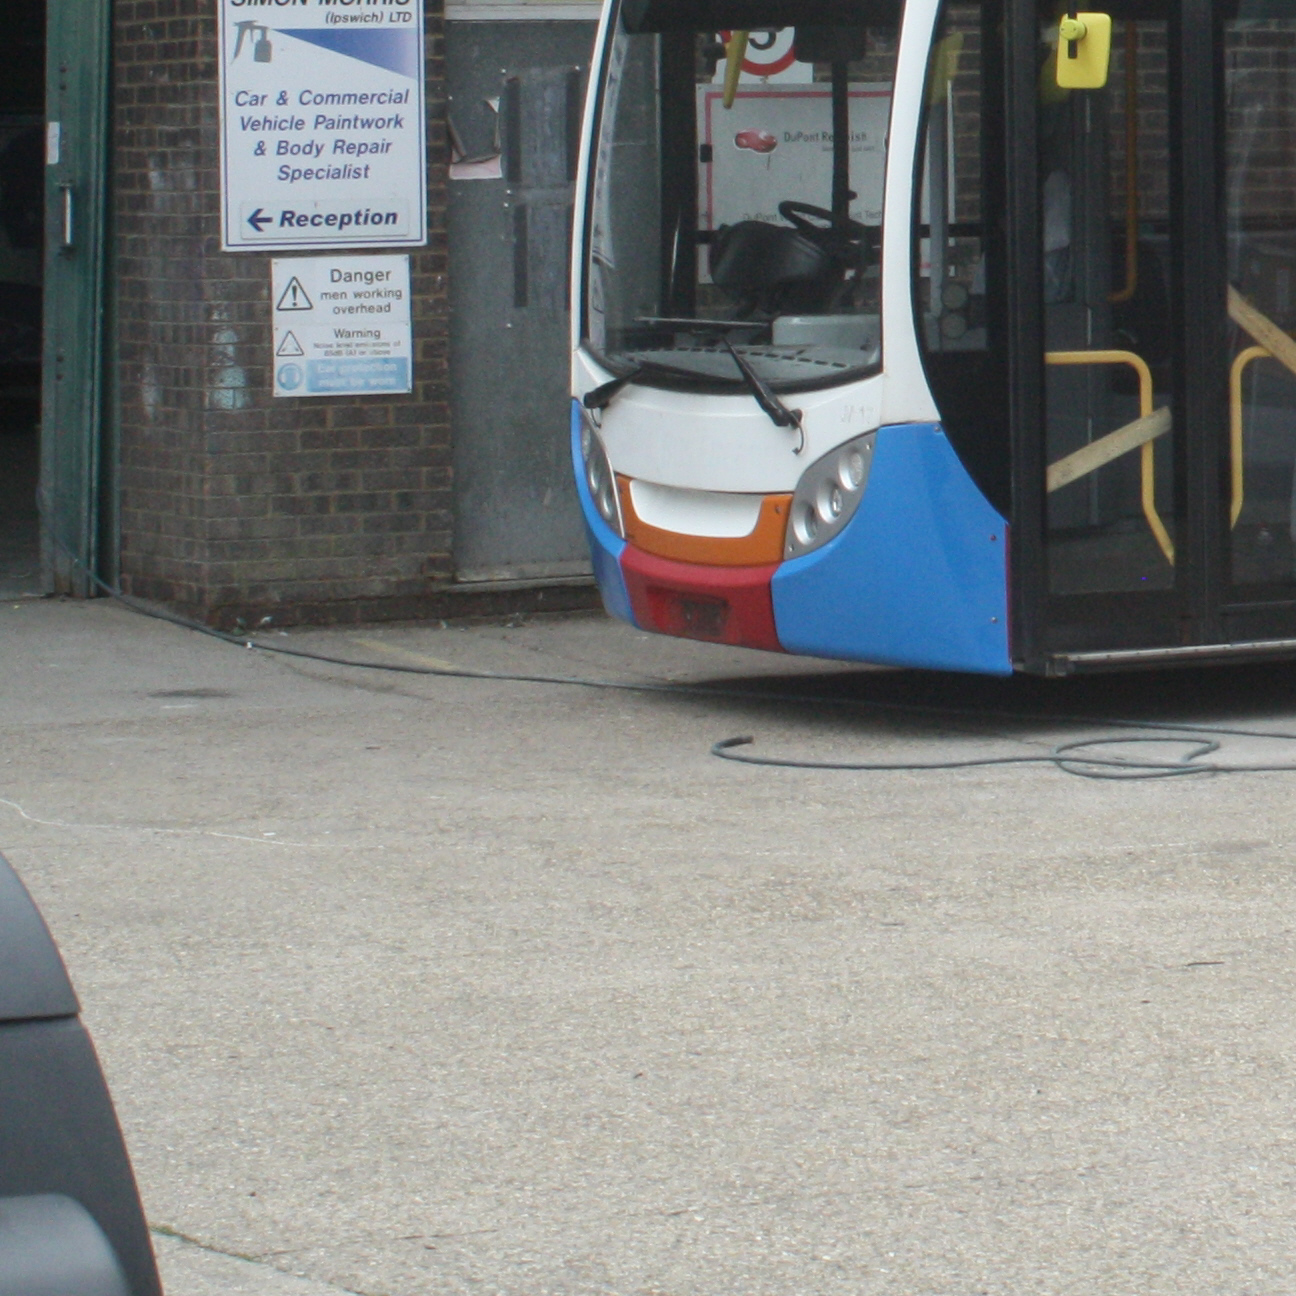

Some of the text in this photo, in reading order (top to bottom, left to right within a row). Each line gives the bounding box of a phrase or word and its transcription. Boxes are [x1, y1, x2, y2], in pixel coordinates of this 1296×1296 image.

[325, 10, 413, 25] (Ipswich) LTD
[235, 88, 410, 107] Car & Commercial
[240, 113, 405, 131] Vehicle Paintwork
[254, 138, 394, 158] & Body Repair
[277, 163, 371, 183] Specialist
[279, 208, 399, 231] Reception
[330, 268, 393, 285] Danger
[320, 287, 403, 301] men working
[332, 302, 392, 315] overhead
[333, 327, 382, 340] Warning
